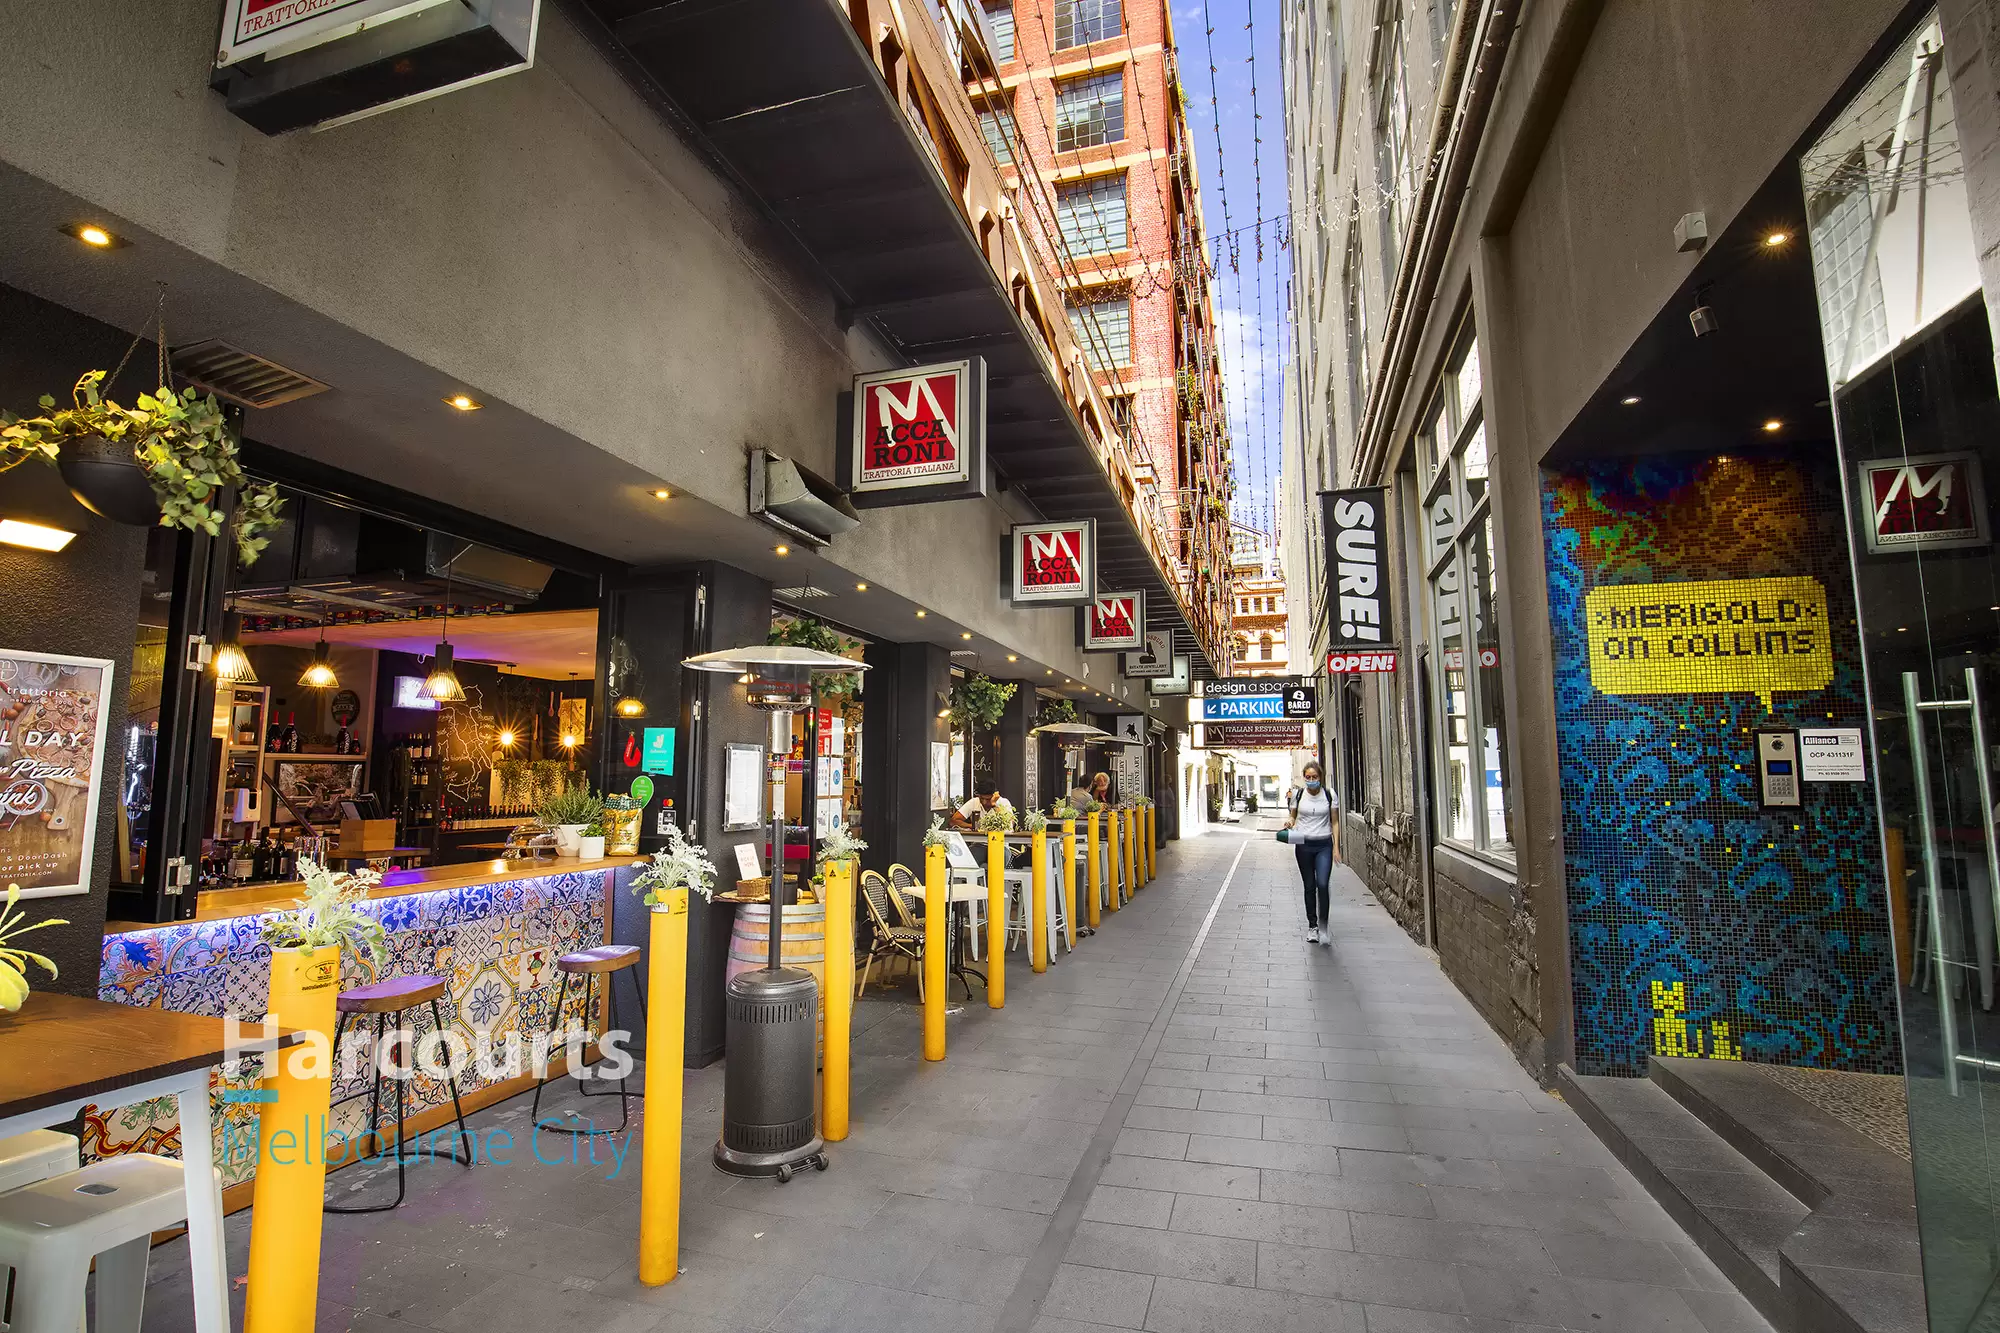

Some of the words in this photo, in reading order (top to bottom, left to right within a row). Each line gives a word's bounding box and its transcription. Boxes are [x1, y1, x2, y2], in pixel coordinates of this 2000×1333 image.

[873, 418, 947, 446] ACCA
[873, 440, 947, 467] RONI
[863, 467, 912, 480] TRATTORIA
[913, 462, 955, 474] ITALIANA
[1026, 556, 1076, 572] ACCA
[1333, 497, 1381, 642] SURE!
[1026, 571, 1076, 586] RONI
[1610, 599, 1801, 629] MERIGOLD
[1329, 655, 1394, 673] OPEN!
[6, 686, 67, 698] trattoria
[1206, 681, 1246, 695] design
[1248, 683, 1257, 692] a
[1220, 700, 1283, 716] PARKING
[1287, 700, 1311, 710] BARED
[1254, 725, 1302, 733] RESTAURANT
[24, 731, 84, 747] DAY
[1805, 736, 1837, 745] Alliance
[9, 758, 77, 779] Pizza
[0, 783, 37, 806] ink
[17, 851, 68, 862] DoorDash
[18, 862, 41, 871] pick
